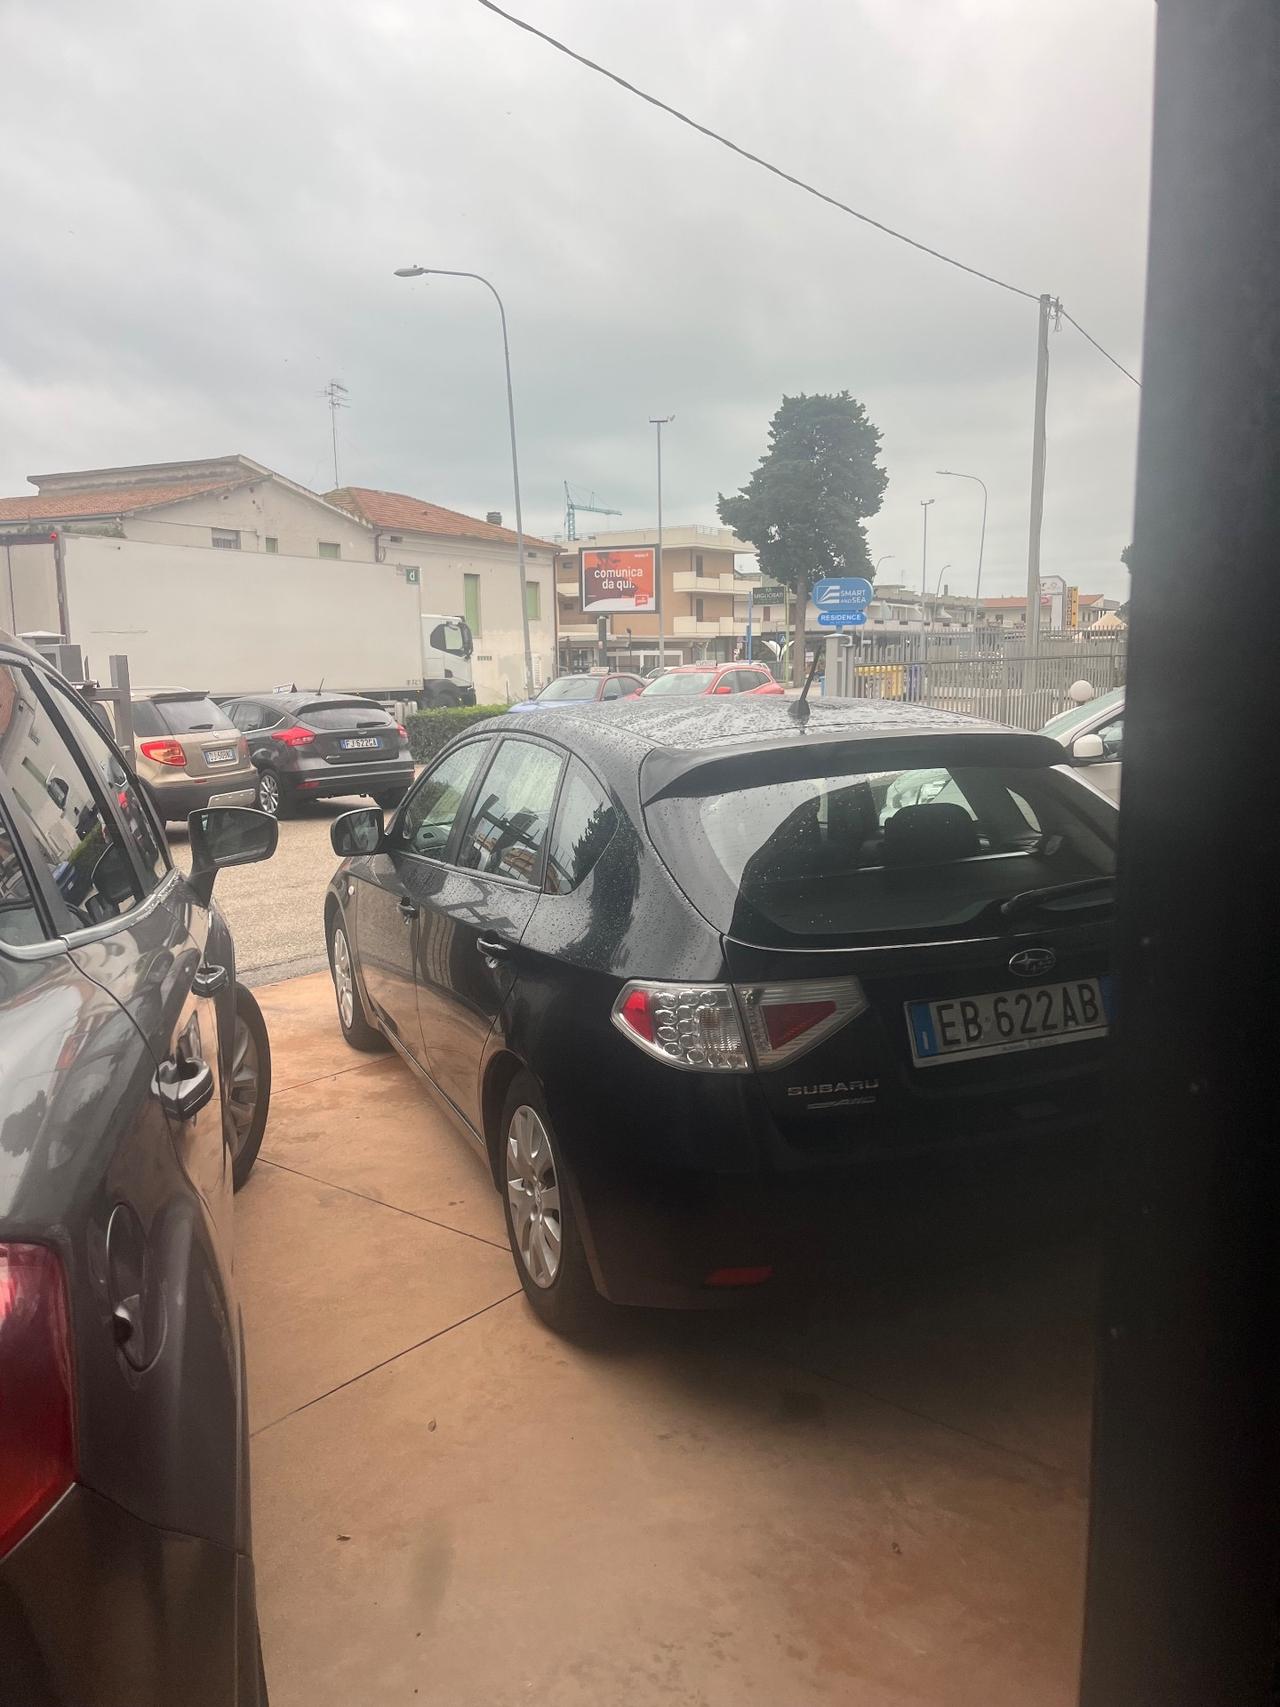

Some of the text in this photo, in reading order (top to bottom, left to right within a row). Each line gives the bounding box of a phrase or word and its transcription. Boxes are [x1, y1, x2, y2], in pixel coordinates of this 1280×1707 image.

[409, 570, 416, 581] d
[594, 566, 643, 579] comunica
[602, 578, 635, 591] da qui.
[840, 589, 866, 597] SMART
[852, 596, 867, 604] SEA
[787, 1078, 880, 1097] SUBARU
